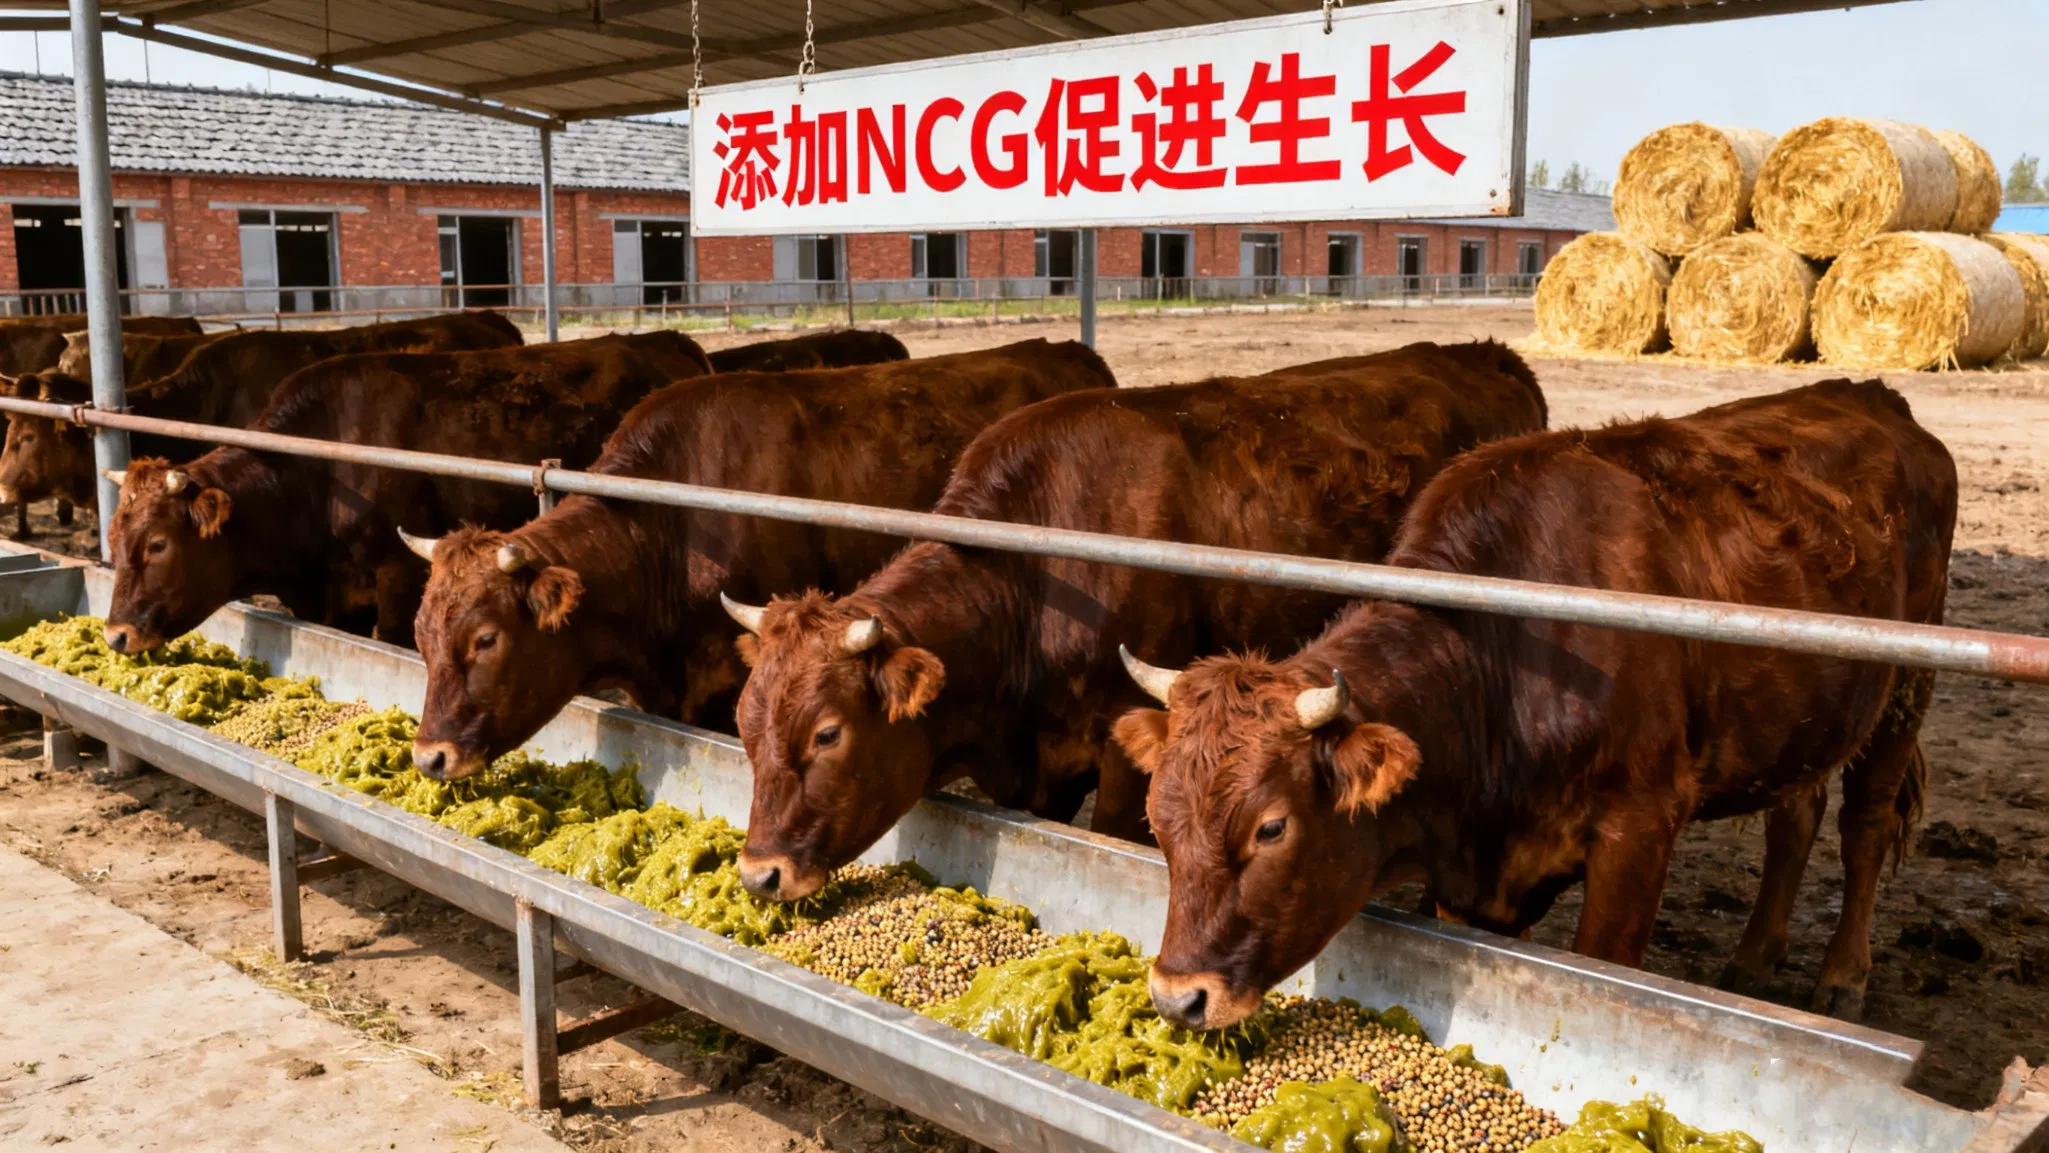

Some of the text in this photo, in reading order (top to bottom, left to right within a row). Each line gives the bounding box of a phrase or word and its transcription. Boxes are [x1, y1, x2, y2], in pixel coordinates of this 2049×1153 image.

[713, 40, 1467, 211] 添加NCG促进生长
